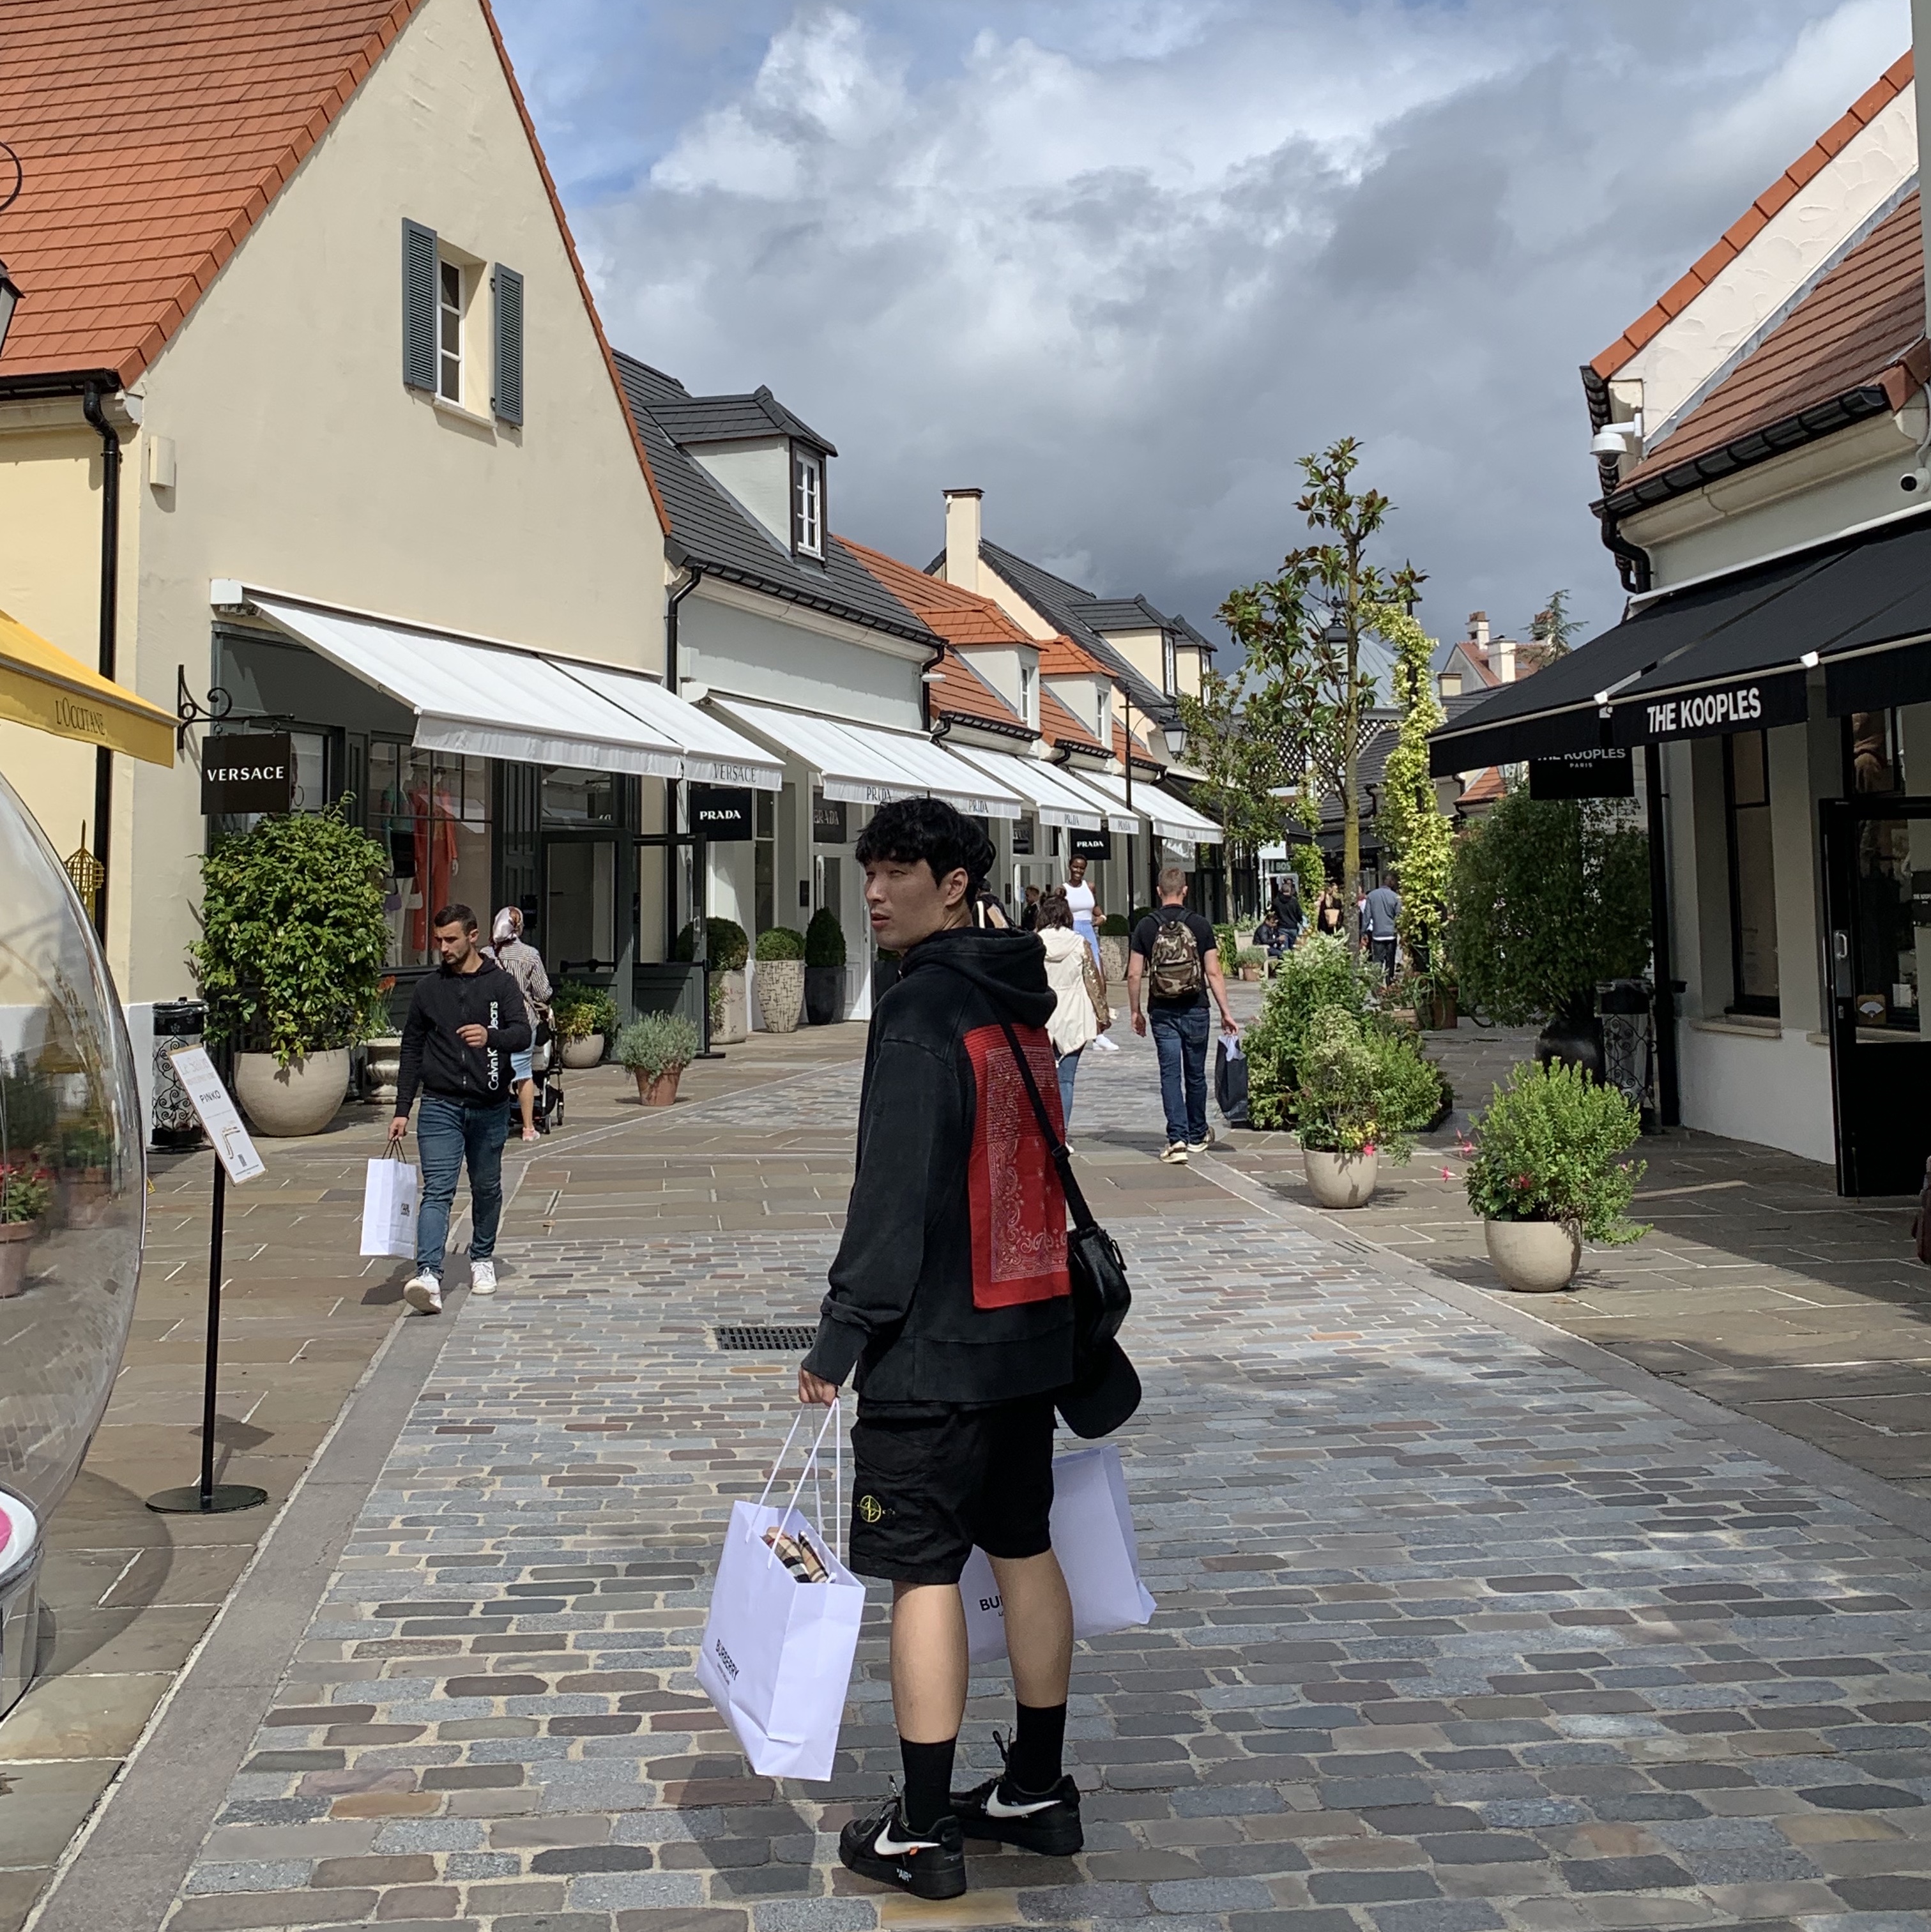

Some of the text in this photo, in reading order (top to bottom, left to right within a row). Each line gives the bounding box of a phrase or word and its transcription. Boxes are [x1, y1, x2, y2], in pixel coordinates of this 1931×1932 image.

[1647, 687, 1761, 733] THE KOOPLES
[207, 766, 284, 782] VERSACE
[714, 763, 756, 783] VERSACE
[699, 809, 742, 820] PRADA
[487, 1001, 499, 1030] Jeans
[487, 1058, 499, 1091] Calvin
[199, 1090, 221, 1104] PINKO
[715, 1638, 740, 1681] BURBERRY
